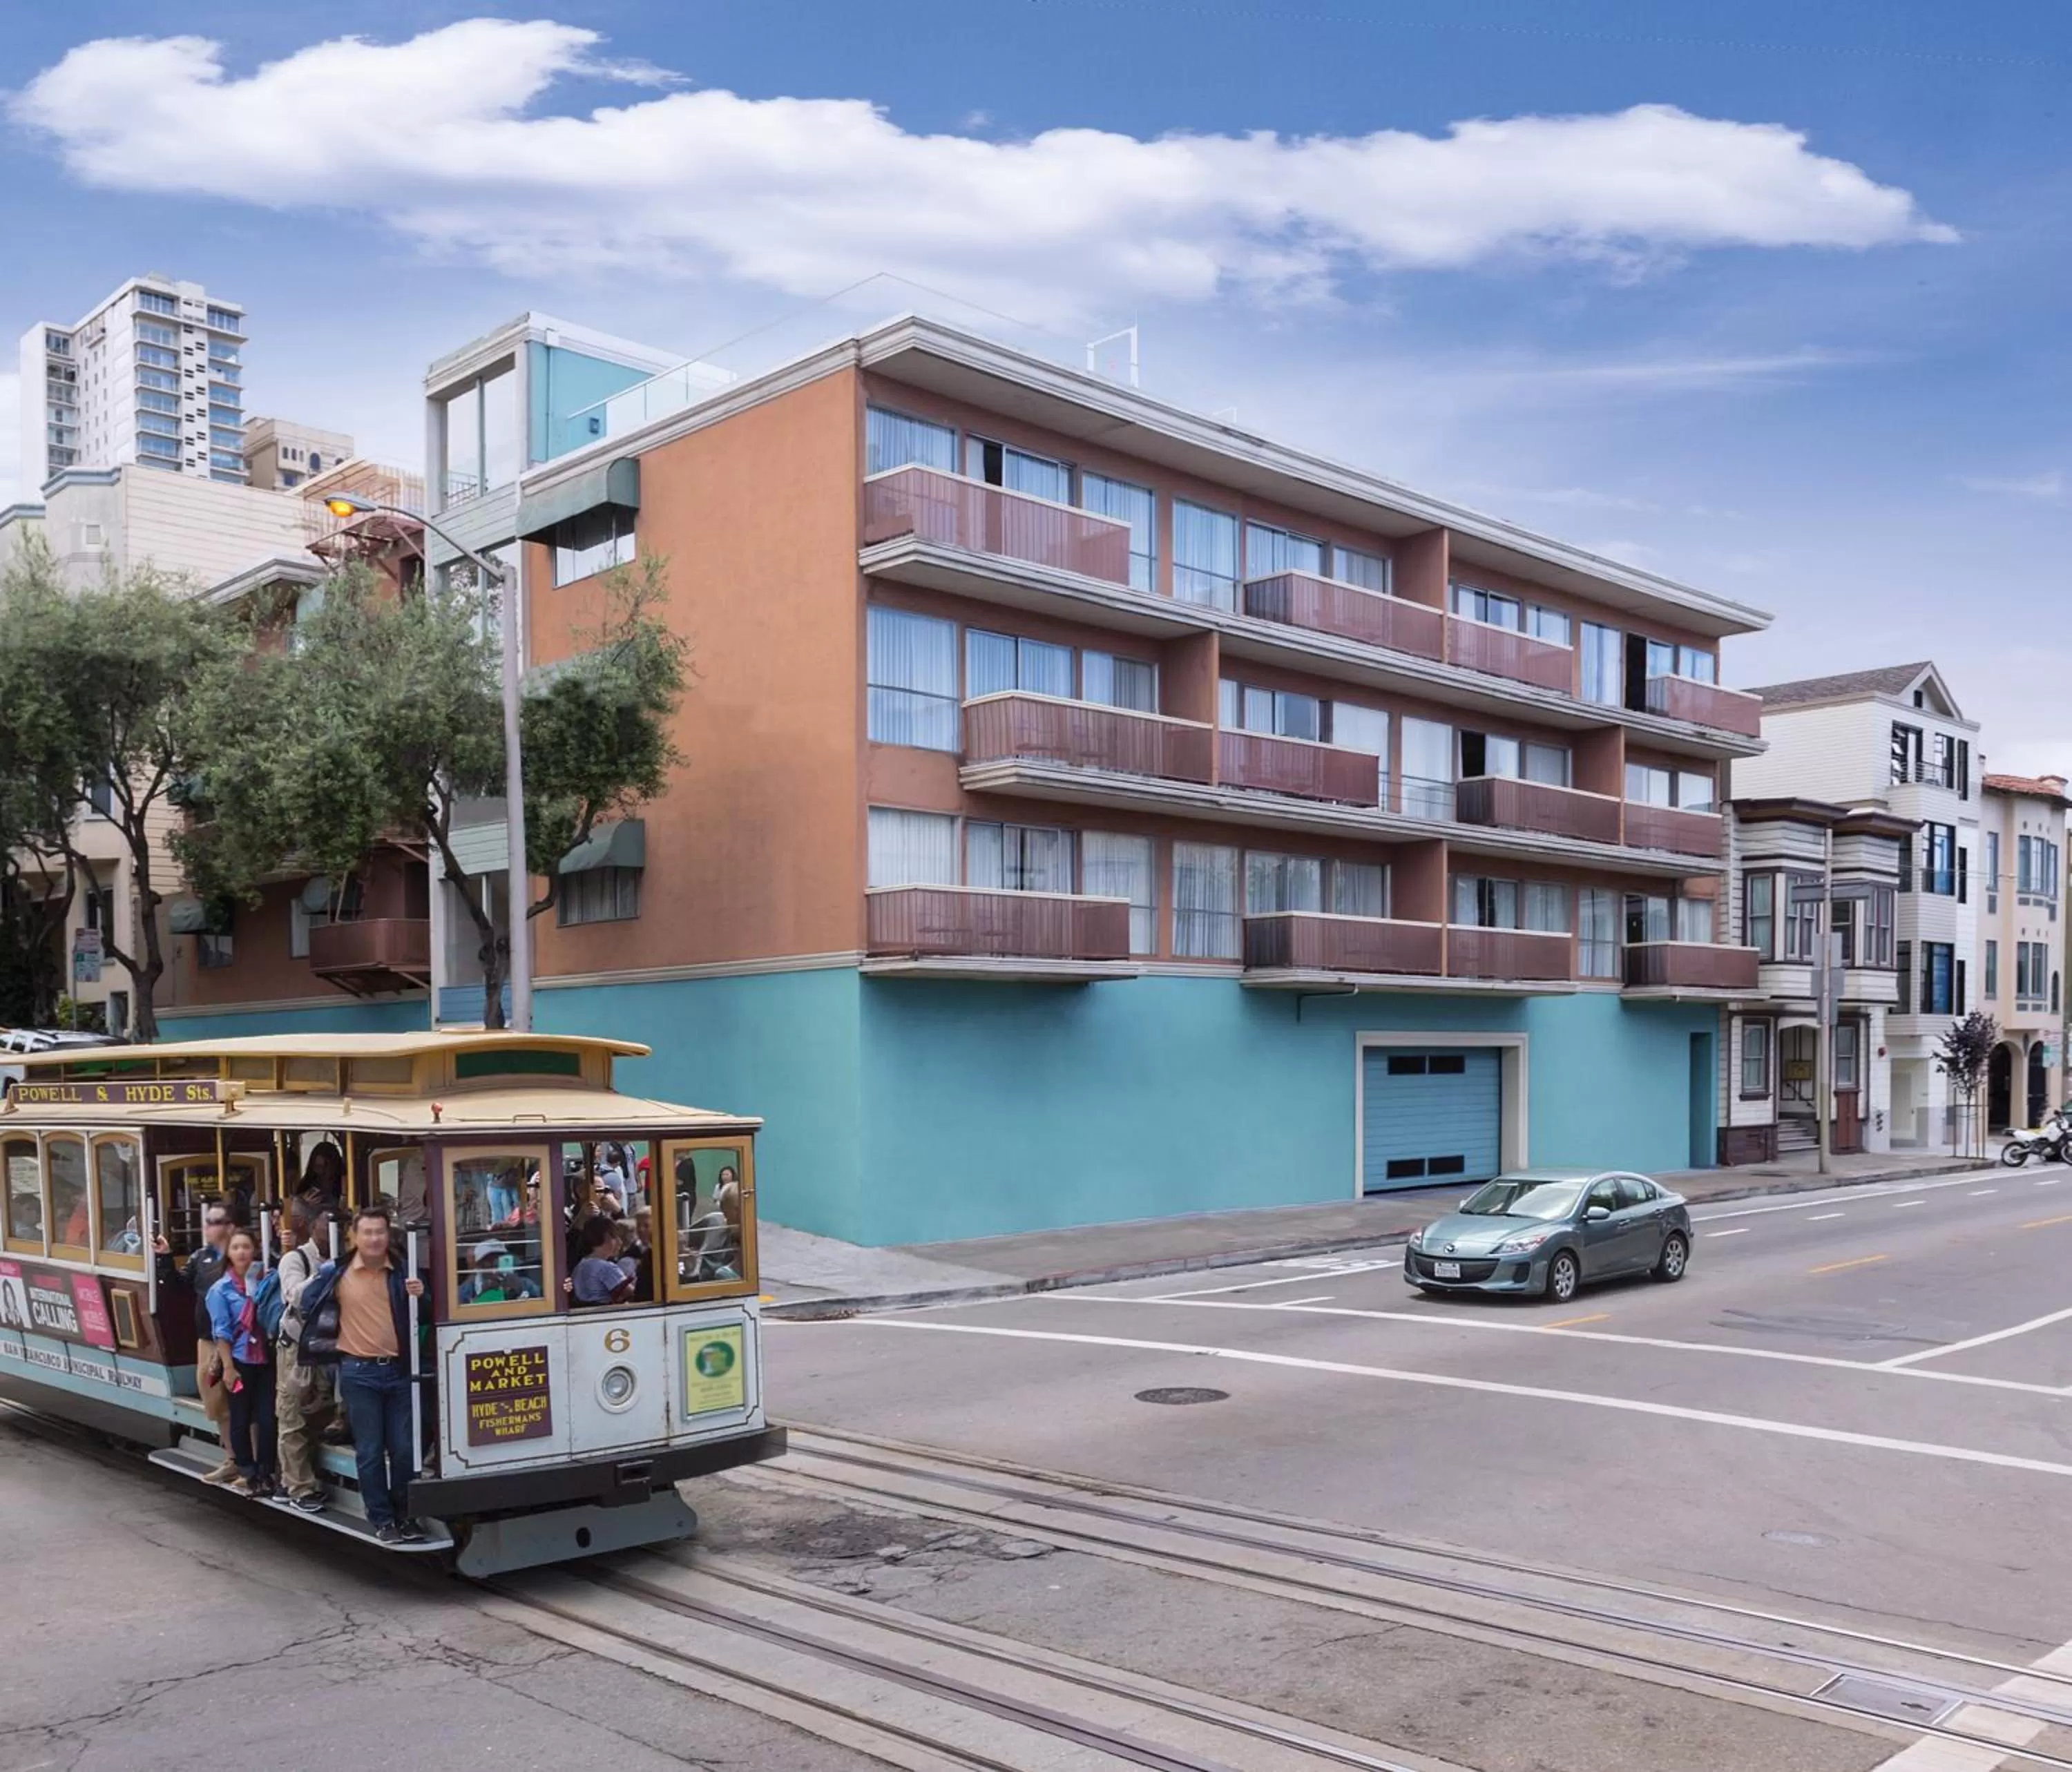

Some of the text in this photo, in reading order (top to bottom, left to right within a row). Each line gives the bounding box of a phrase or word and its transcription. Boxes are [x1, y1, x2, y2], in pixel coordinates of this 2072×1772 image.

[18, 1084, 213, 1101] POWELL & HYDE Sts.
[32, 1301, 79, 1333] CALLING
[604, 1328, 630, 1353] 6
[63, 1358, 105, 1380] MNICIPAL
[470, 1353, 545, 1371] POWELL
[490, 1366, 527, 1378] AND
[470, 1374, 546, 1392] MARKET
[472, 1403, 498, 1418] HYDE
[514, 1396, 547, 1412] BEACH
[479, 1412, 542, 1429] FISHERMANS
